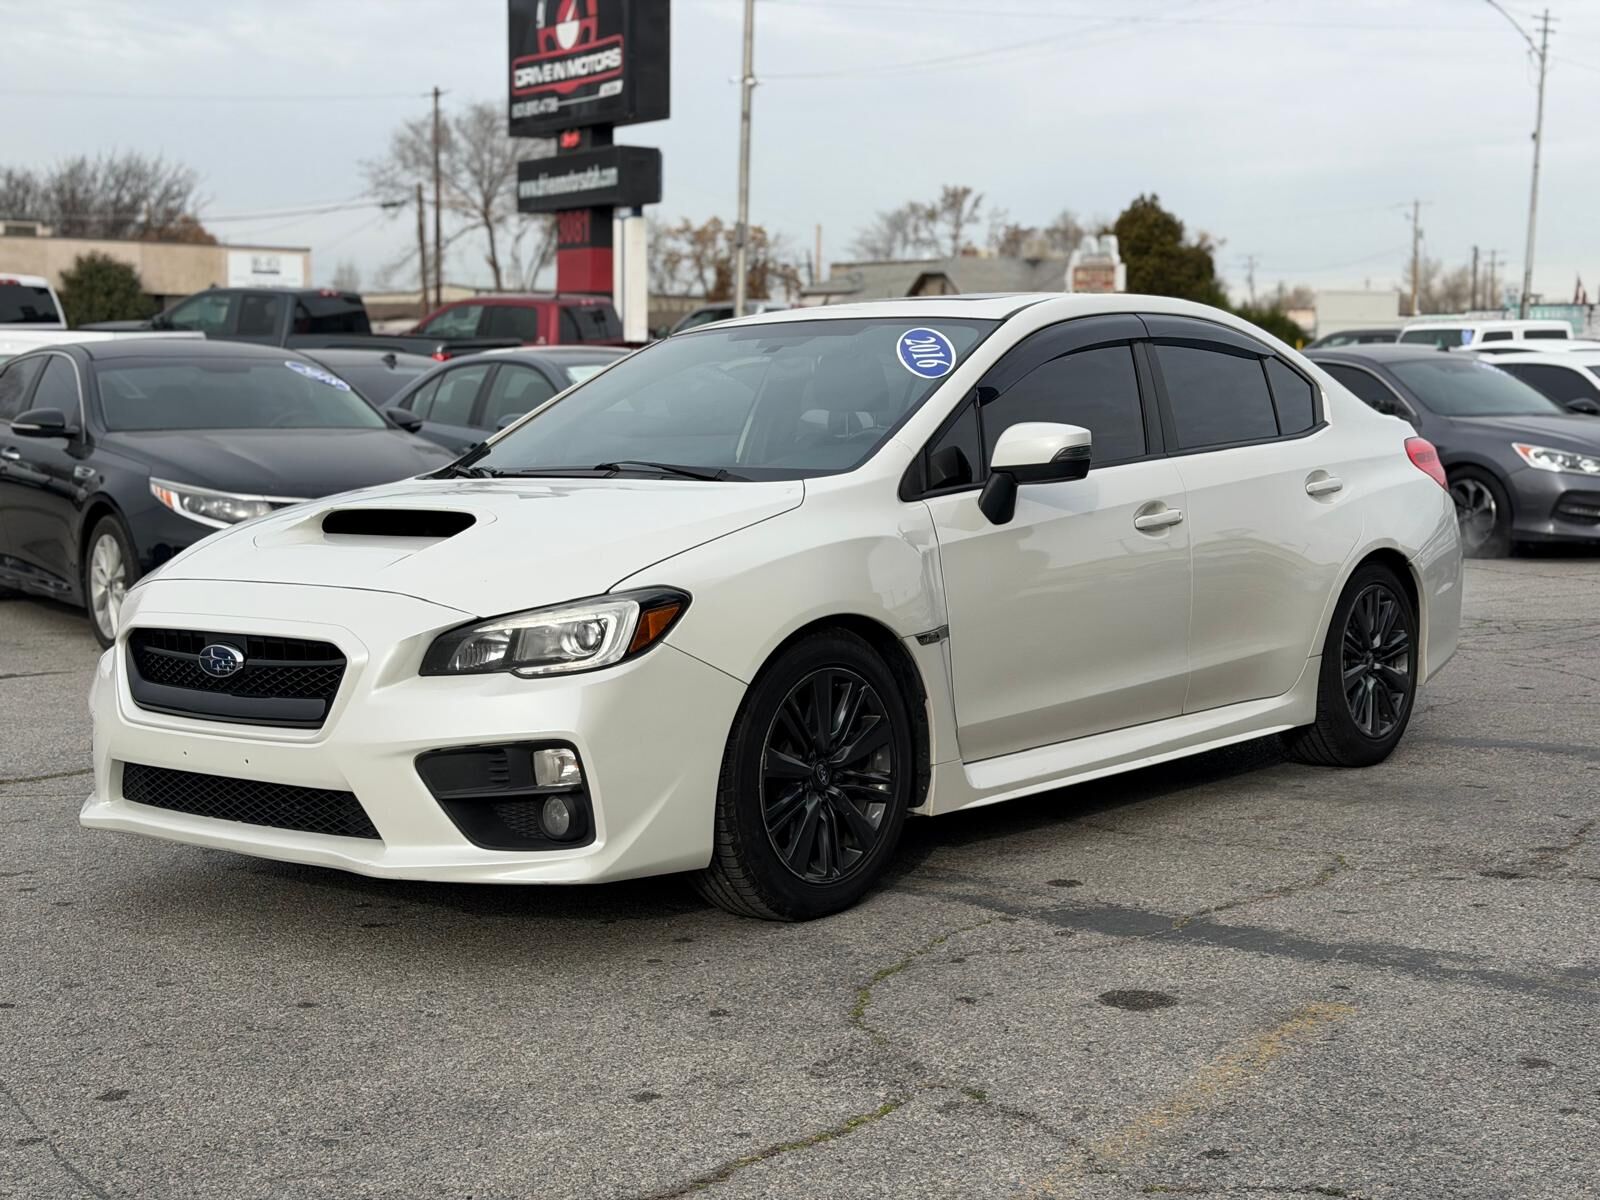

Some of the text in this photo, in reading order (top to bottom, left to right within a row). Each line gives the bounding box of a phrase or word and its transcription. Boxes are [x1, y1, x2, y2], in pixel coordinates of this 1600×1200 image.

[513, 60, 567, 88] DRIVEN
[568, 47, 622, 78] MOTORS
[904, 336, 950, 368] 2016
